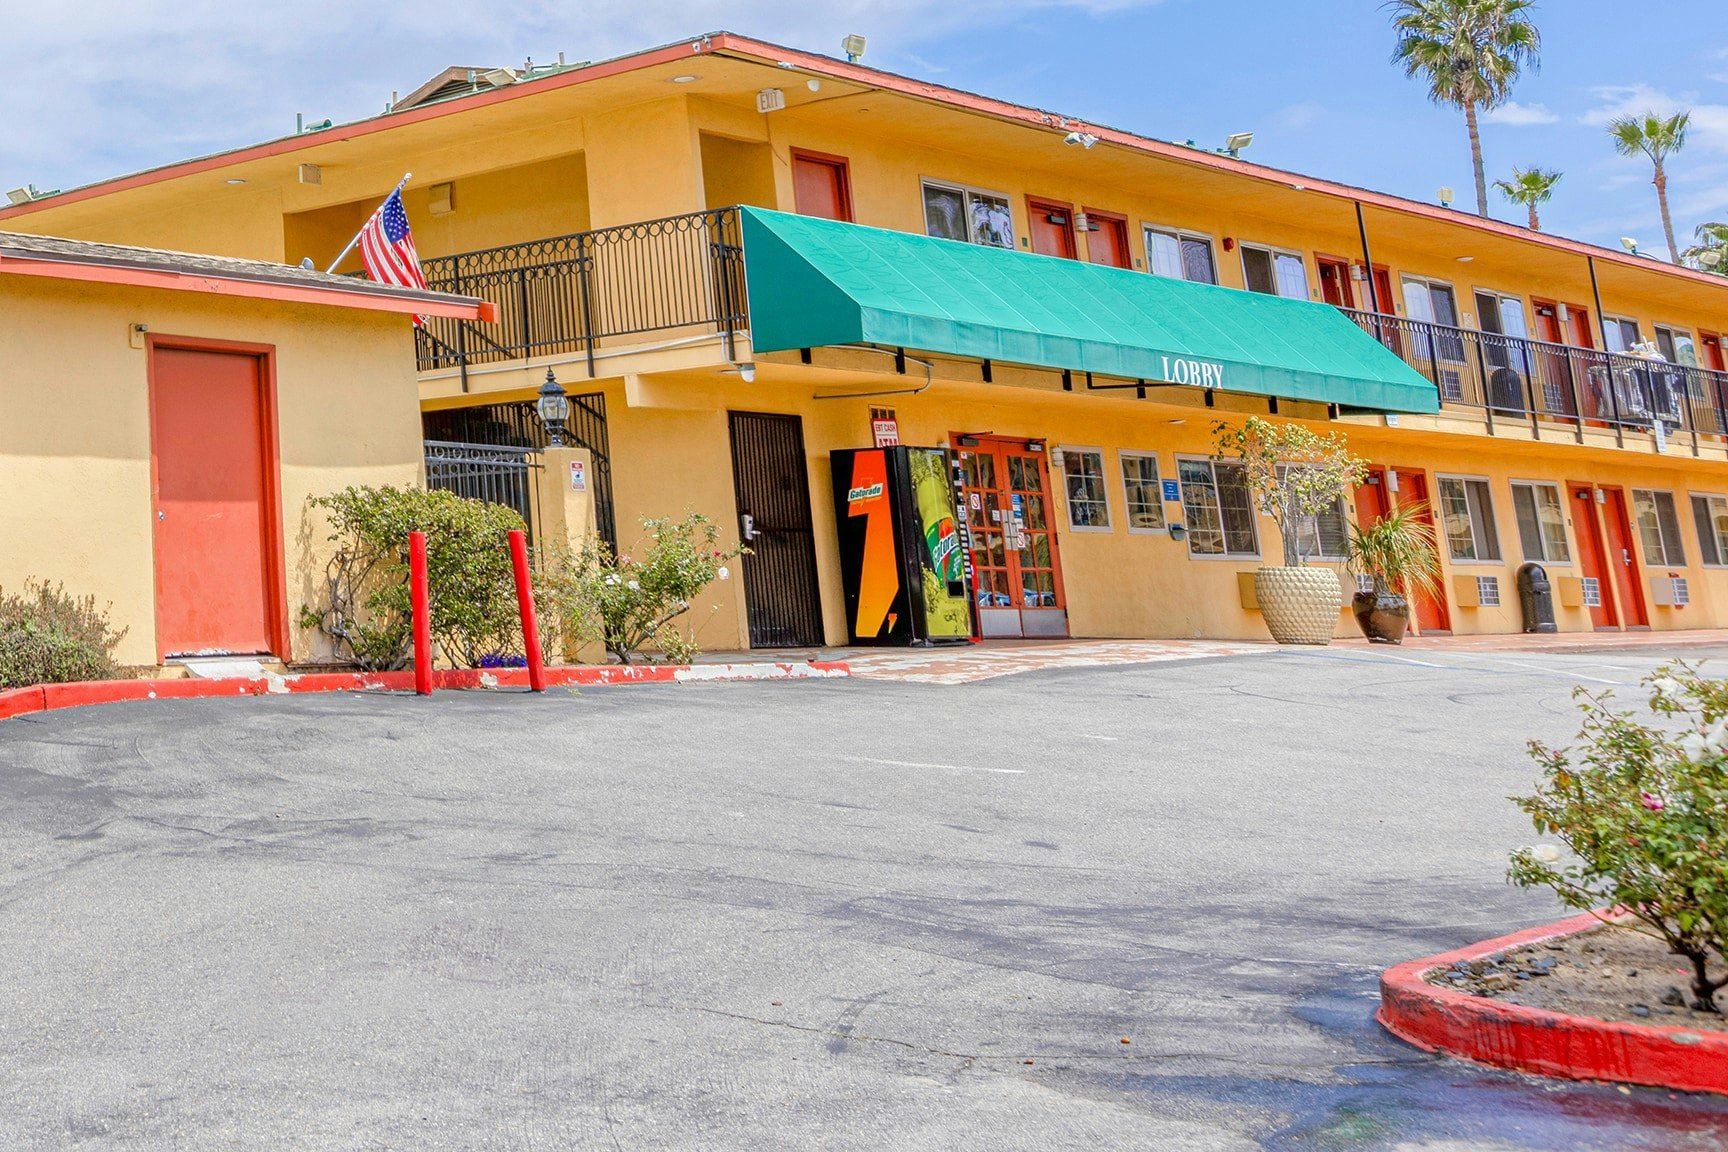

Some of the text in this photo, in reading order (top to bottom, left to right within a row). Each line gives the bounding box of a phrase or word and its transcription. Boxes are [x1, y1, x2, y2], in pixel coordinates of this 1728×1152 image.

[760, 92, 778, 110] EXIT
[1161, 356, 1223, 389] LOBBY
[884, 424, 896, 432] CASH
[849, 486, 881, 499] Gatorade
